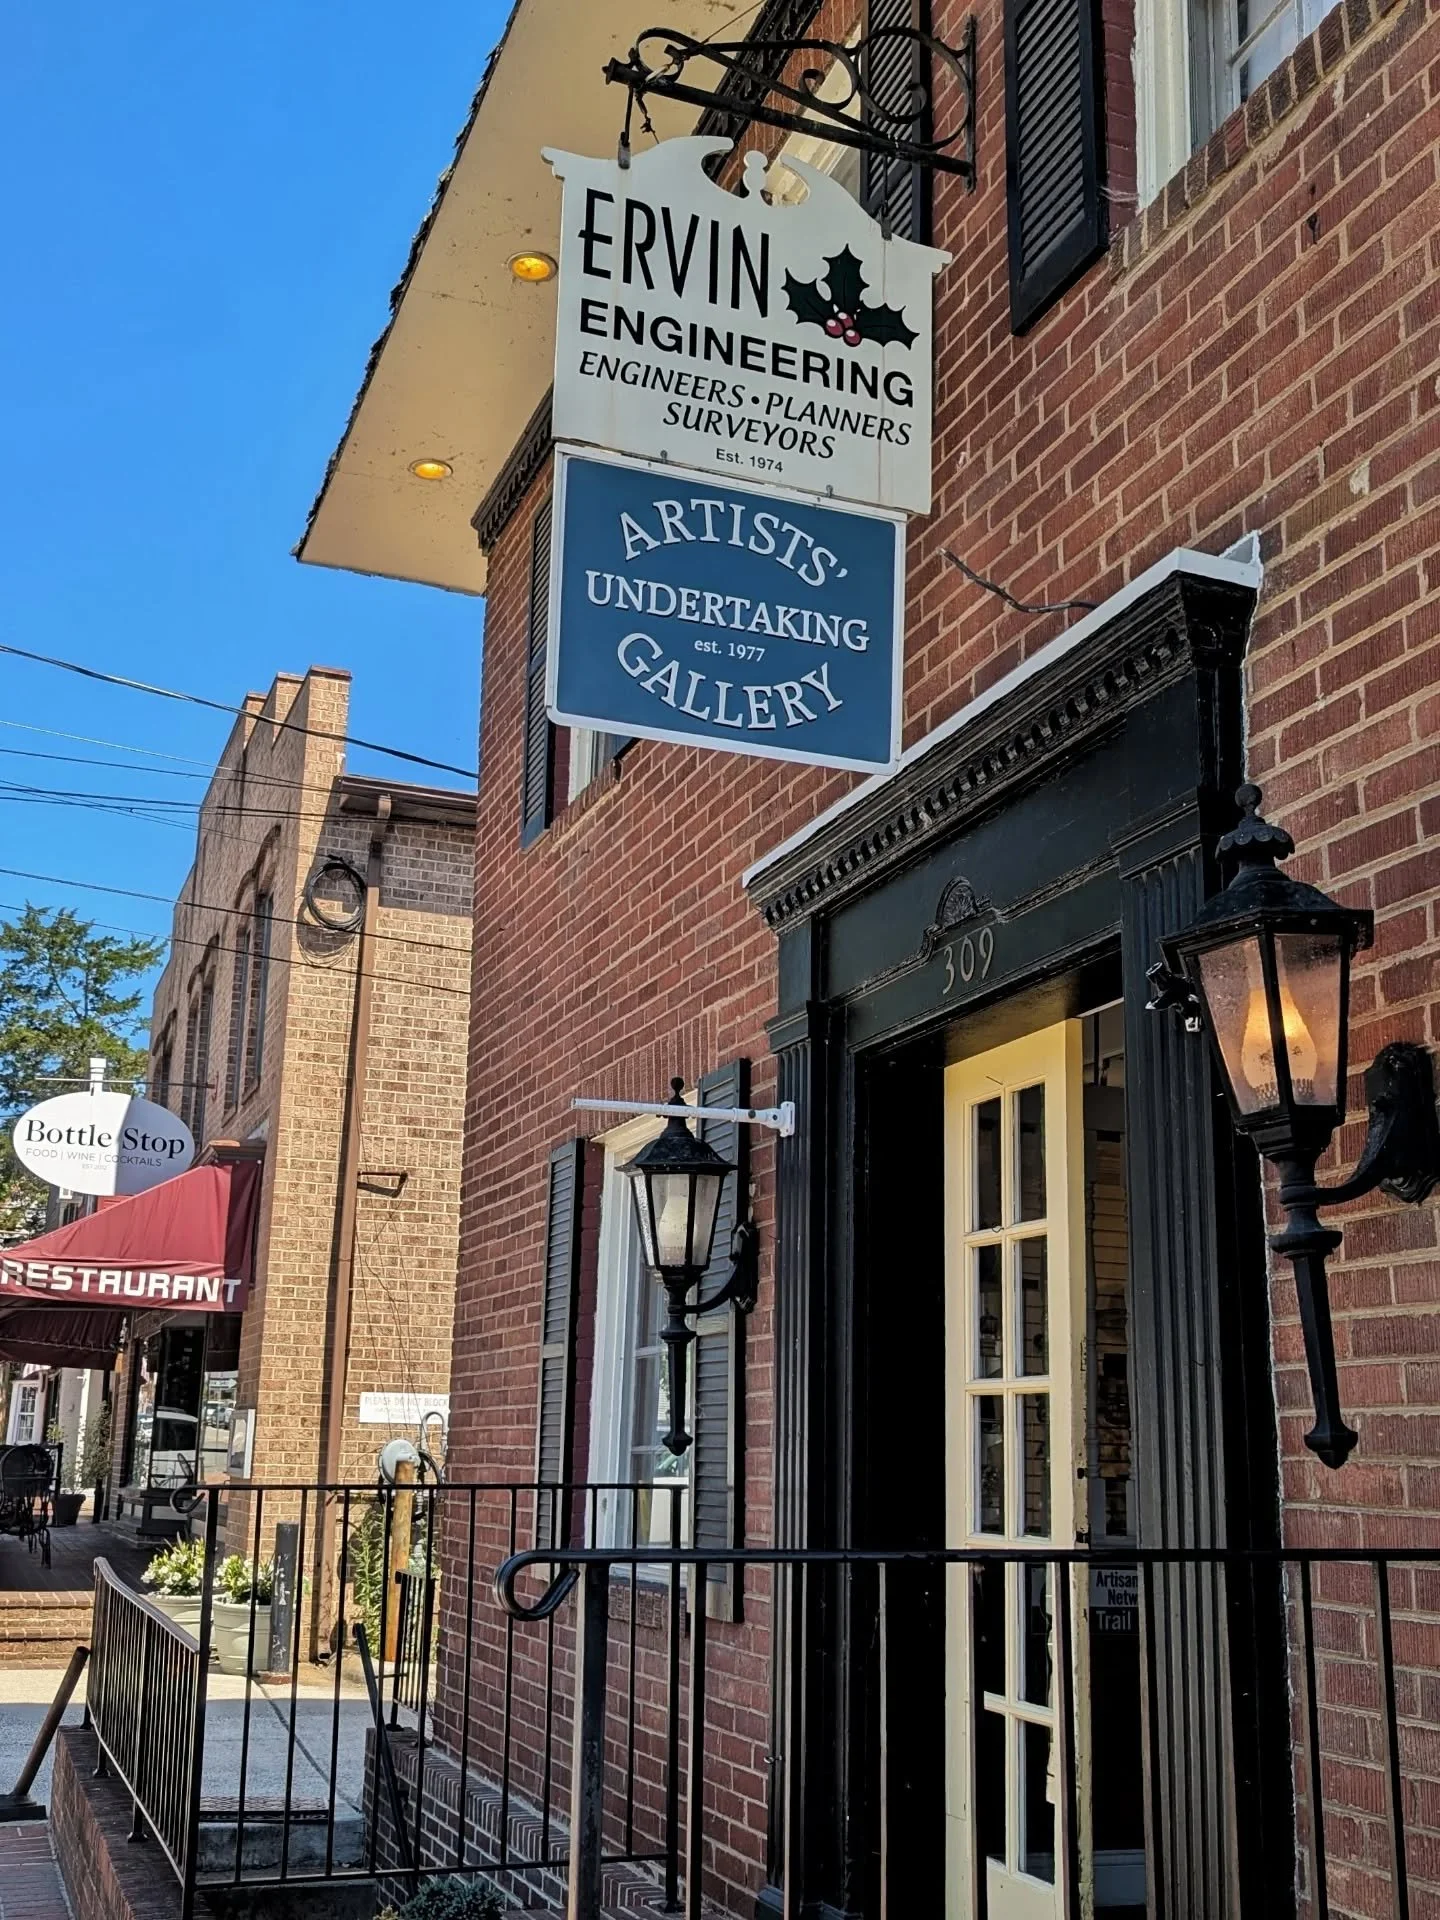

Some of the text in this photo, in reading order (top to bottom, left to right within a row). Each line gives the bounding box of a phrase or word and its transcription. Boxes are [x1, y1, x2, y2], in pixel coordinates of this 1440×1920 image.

[578, 187, 769, 318] ERVIN
[579, 298, 914, 408] ENGINEERING
[579, 351, 912, 446] ENGINEERS PLANNERS
[662, 402, 836, 459] SURVEYORS
[716, 448, 784, 473] Est. 1974
[585, 569, 870, 651] UNDERTAKING
[694, 638, 766, 663] est. 1977
[617, 632, 843, 729] GALLERY
[942, 927, 994, 995] 309
[24, 1119, 185, 1159] Bottle Stop
[25, 1148, 163, 1168] FOOD WINE COCKTAILS
[1, 1259, 242, 1304] RESTAURANT
[1096, 1610, 1131, 1630] Trail
